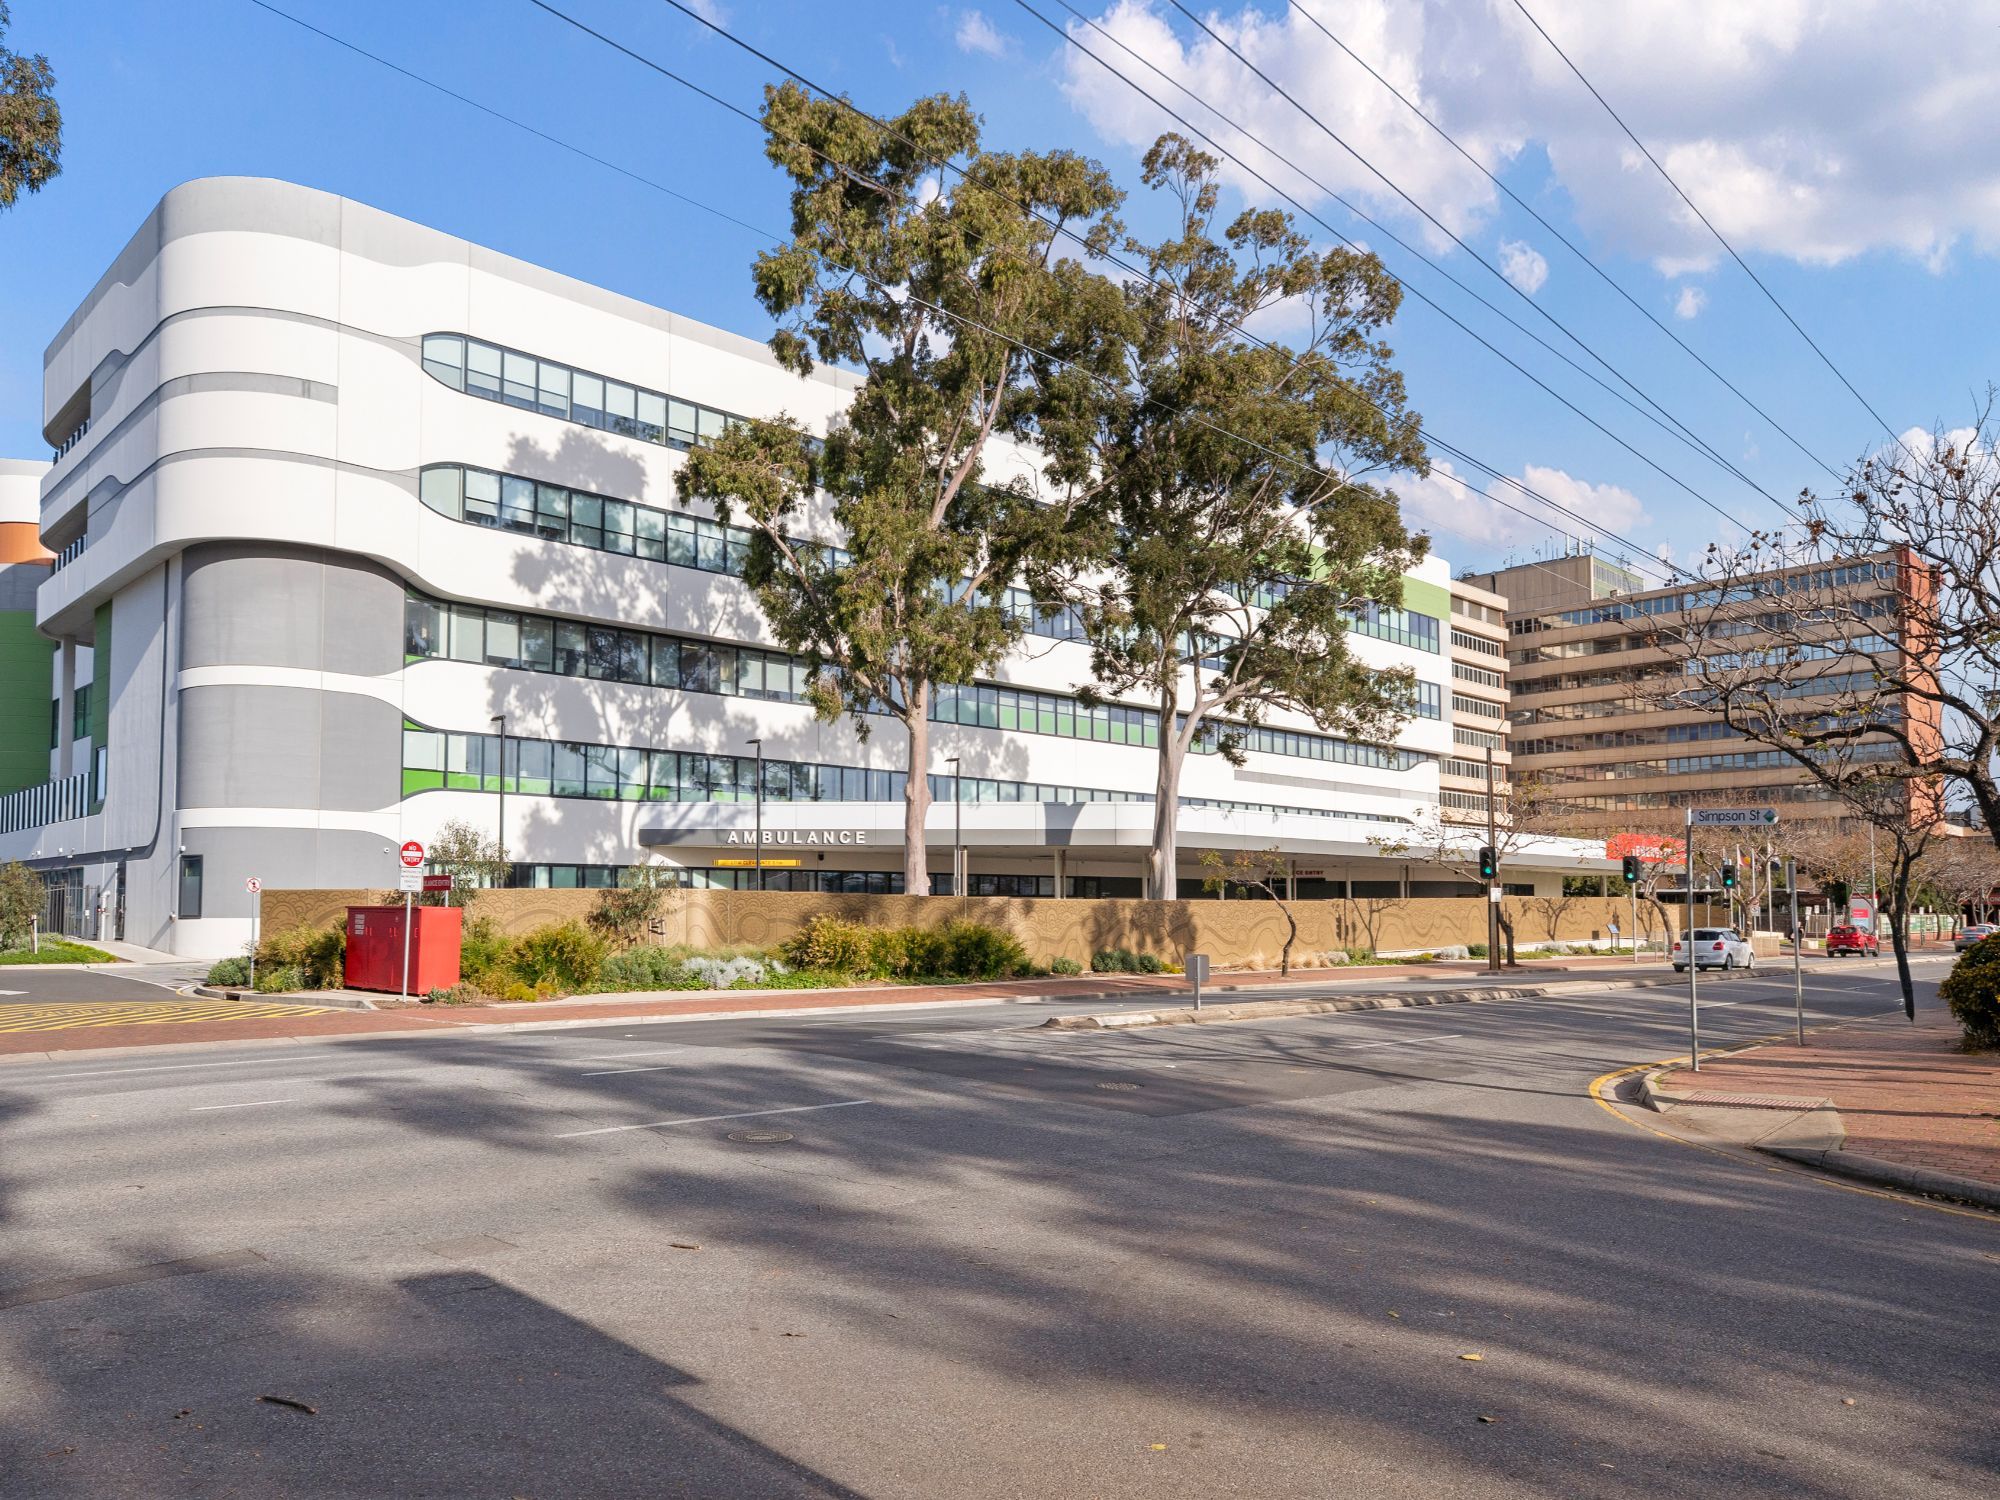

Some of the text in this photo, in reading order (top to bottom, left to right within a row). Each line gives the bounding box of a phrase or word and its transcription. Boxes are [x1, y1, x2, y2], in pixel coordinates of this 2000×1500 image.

[1698, 809, 1761, 823] Simpson St
[727, 831, 866, 844] AMBULANCE
